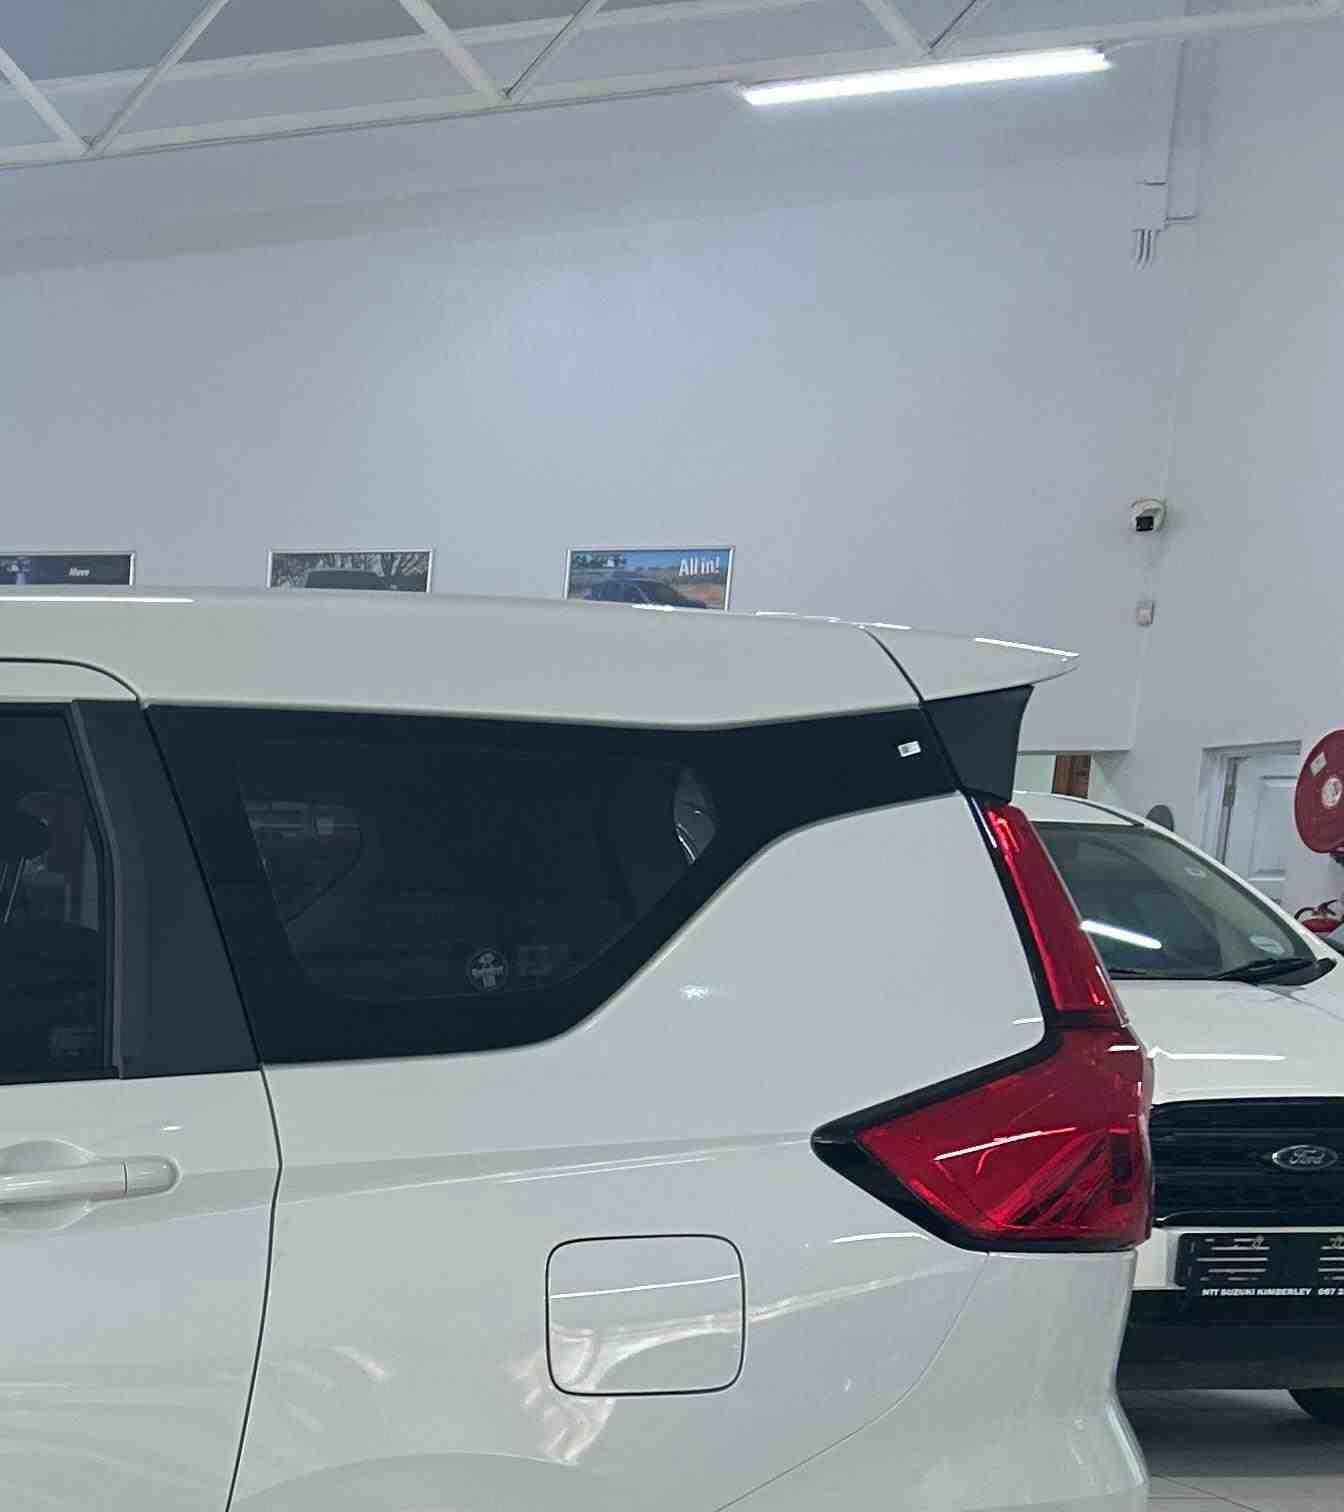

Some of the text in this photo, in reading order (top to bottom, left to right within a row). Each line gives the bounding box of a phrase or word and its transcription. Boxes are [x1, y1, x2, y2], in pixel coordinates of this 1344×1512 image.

[678, 555, 720, 577] All in!
[1288, 1148, 1326, 1165] Ford
[1220, 1287, 1255, 1297] SUZUKI
[1256, 1287, 1313, 1297] KIMBERLEY
